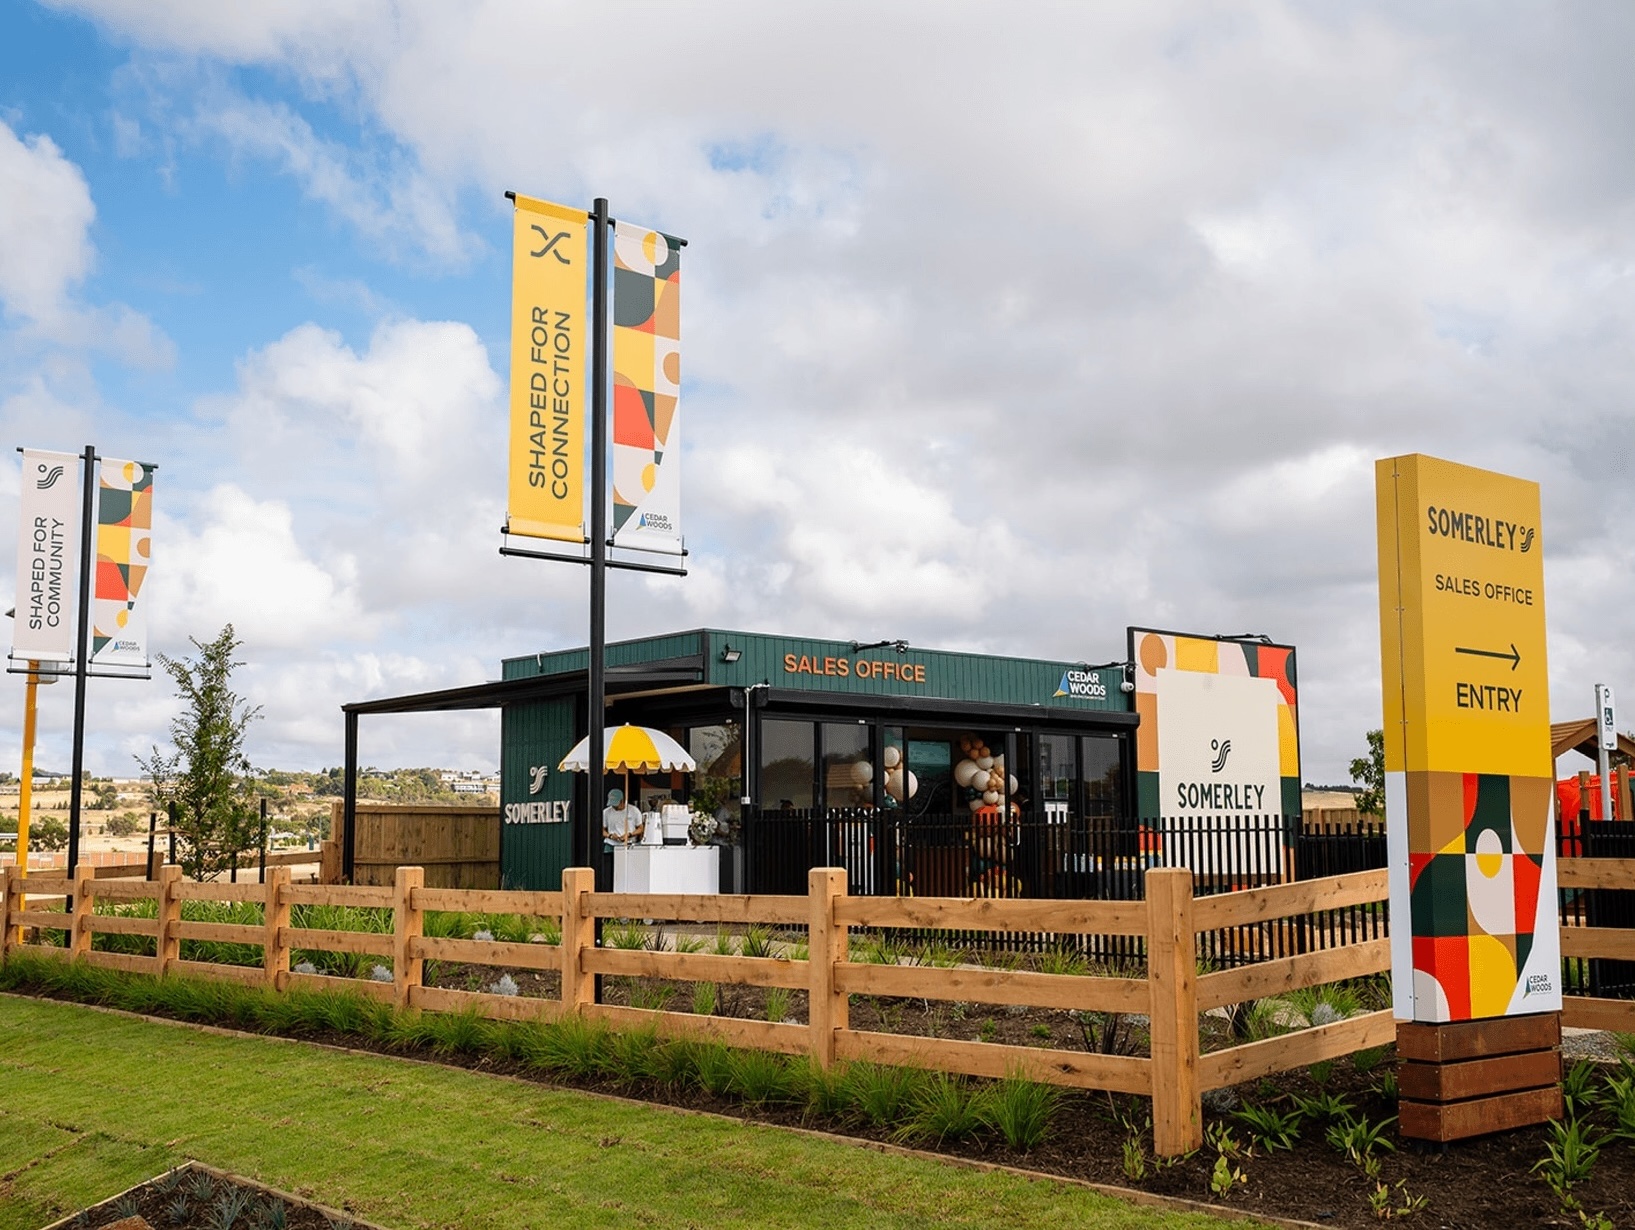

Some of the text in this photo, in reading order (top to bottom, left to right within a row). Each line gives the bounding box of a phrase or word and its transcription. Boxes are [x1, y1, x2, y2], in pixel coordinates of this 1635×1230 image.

[529, 306, 548, 489] SHAPED FOR
[552, 311, 571, 501] CONNECTION
[645, 512, 668, 522] CEDAR
[647, 521, 673, 530] WOODS
[1427, 505, 1517, 551] SOMERLEY
[29, 516, 47, 630] SHAPED FOR
[47, 518, 64, 628] COMMUNITY
[1435, 574, 1533, 606] SALES OFFICE
[784, 653, 926, 683] SALES OFFICE
[1067, 670, 1099, 683] CEDAR
[1069, 682, 1106, 696] WOODS
[1456, 682, 1522, 713] ENTRY
[1177, 782, 1266, 810] SOMERLEY
[504, 800, 571, 825] SOMERLEY
[1529, 974, 1548, 984] CEDAR
[1531, 983, 1552, 992] WOODS
